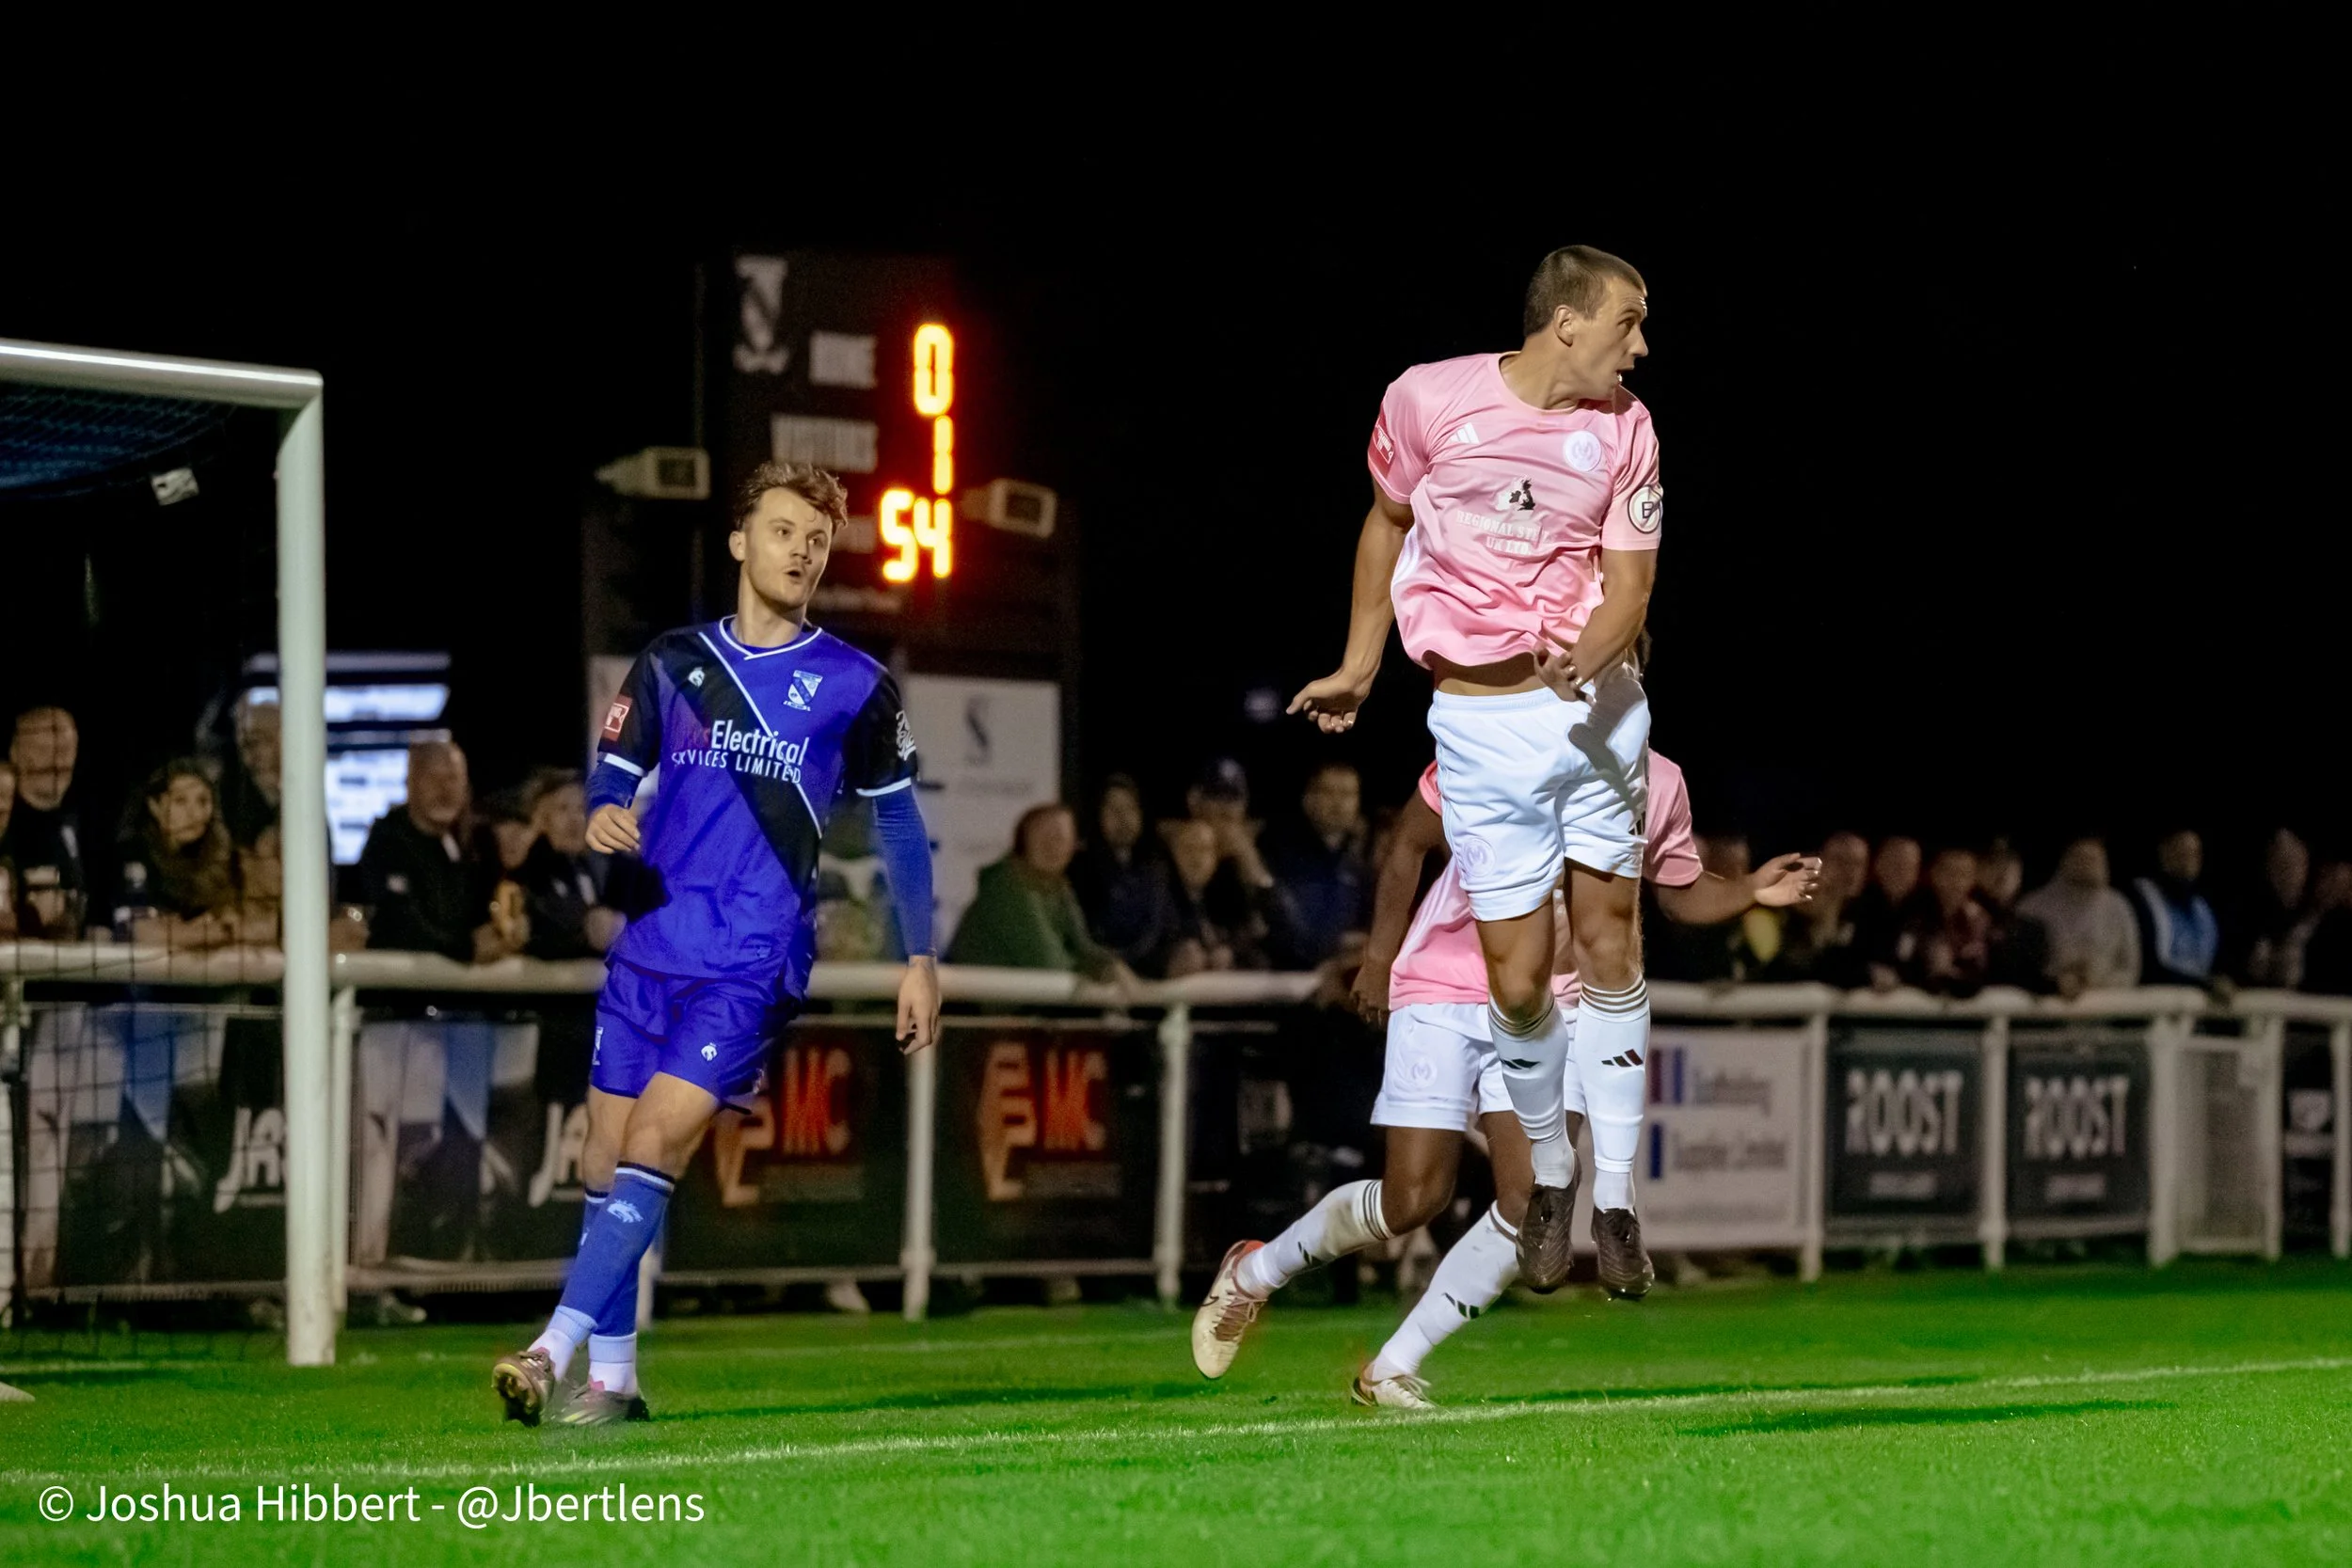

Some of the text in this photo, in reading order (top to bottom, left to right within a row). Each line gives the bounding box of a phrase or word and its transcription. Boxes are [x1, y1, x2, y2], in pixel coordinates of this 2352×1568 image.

[914, 324, 953, 416] 0
[933, 415, 953, 494] 1
[880, 489, 952, 581] 54
[1455, 510, 1514, 537] REGIONAL
[1486, 536, 1503, 551] UK
[710, 719, 809, 766] Electrical
[735, 754, 801, 784] LIMITED
